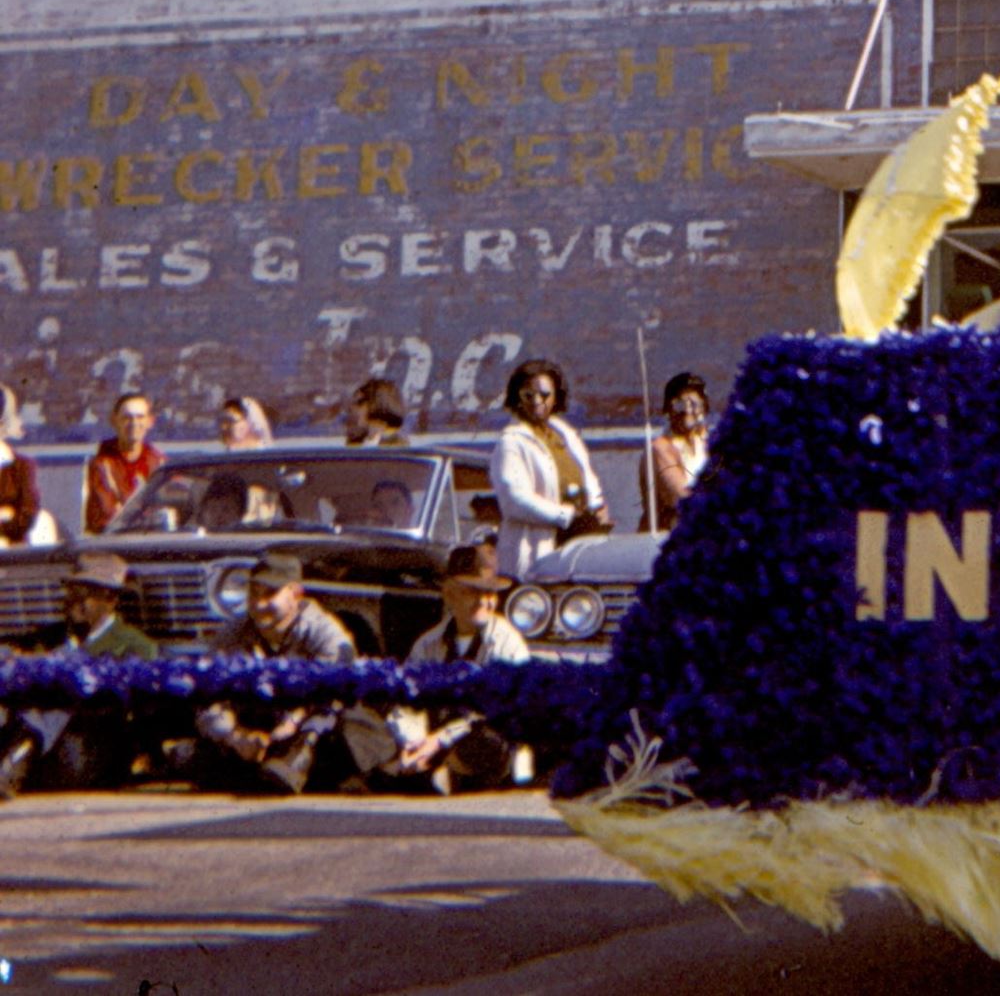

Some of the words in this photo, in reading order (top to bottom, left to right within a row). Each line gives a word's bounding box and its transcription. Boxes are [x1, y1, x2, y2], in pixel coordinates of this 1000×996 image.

[88, 64, 290, 129] DAY
[336, 58, 390, 115] &
[437, 41, 750, 111] NIGHT
[0, 142, 413, 212] WRECKER
[252, 236, 299, 282] &
[339, 220, 740, 280] SERVICE
